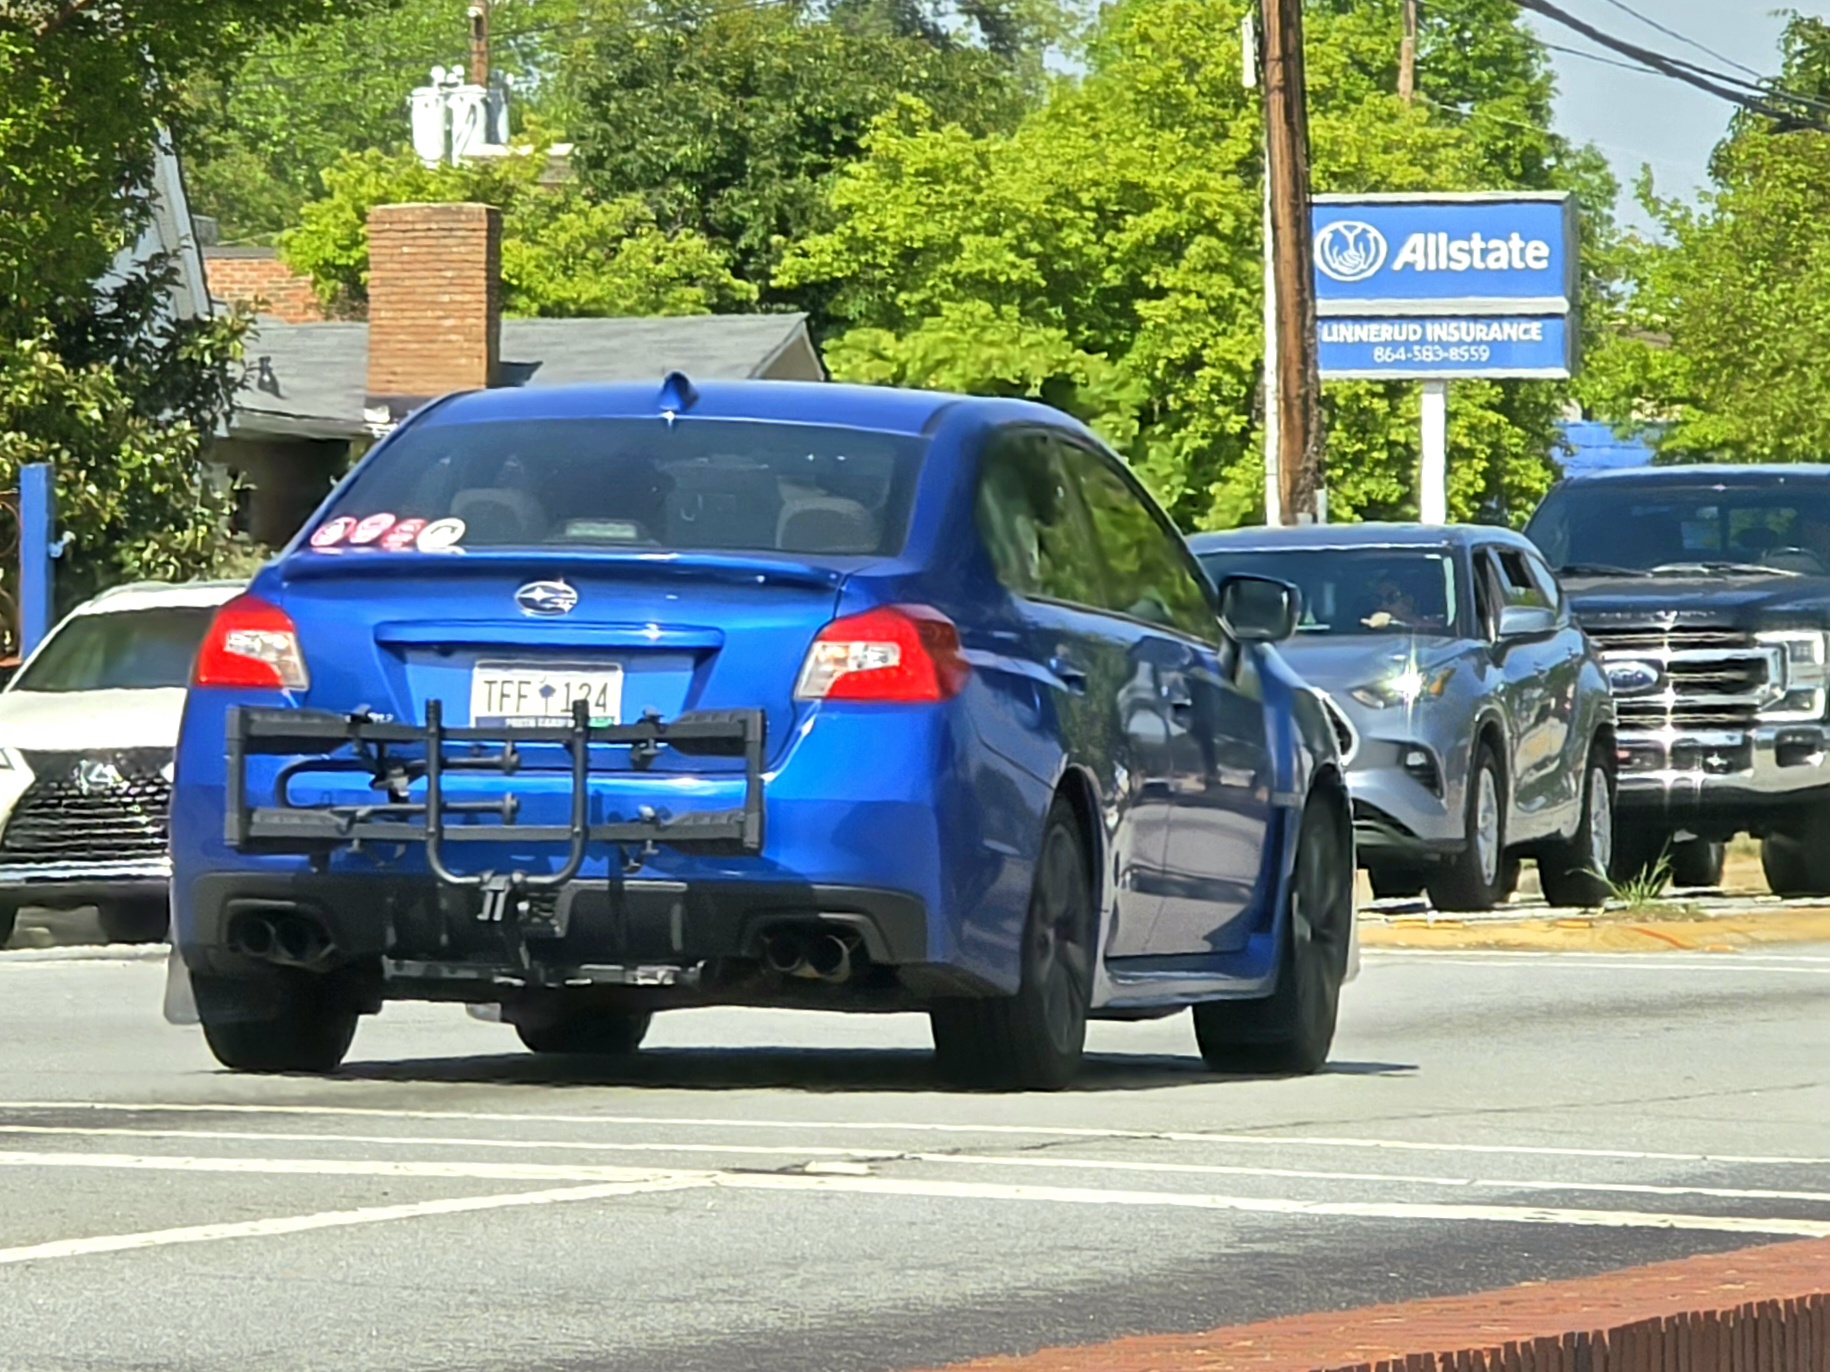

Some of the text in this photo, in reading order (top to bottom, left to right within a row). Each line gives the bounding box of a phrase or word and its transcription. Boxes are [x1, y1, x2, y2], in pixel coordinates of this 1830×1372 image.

[1391, 232, 1551, 272] Allstate
[1321, 321, 1543, 343] LINNERUD INSURANCE
[1373, 345, 1490, 363] 864-583-8559
[483, 679, 532, 713] TFF
